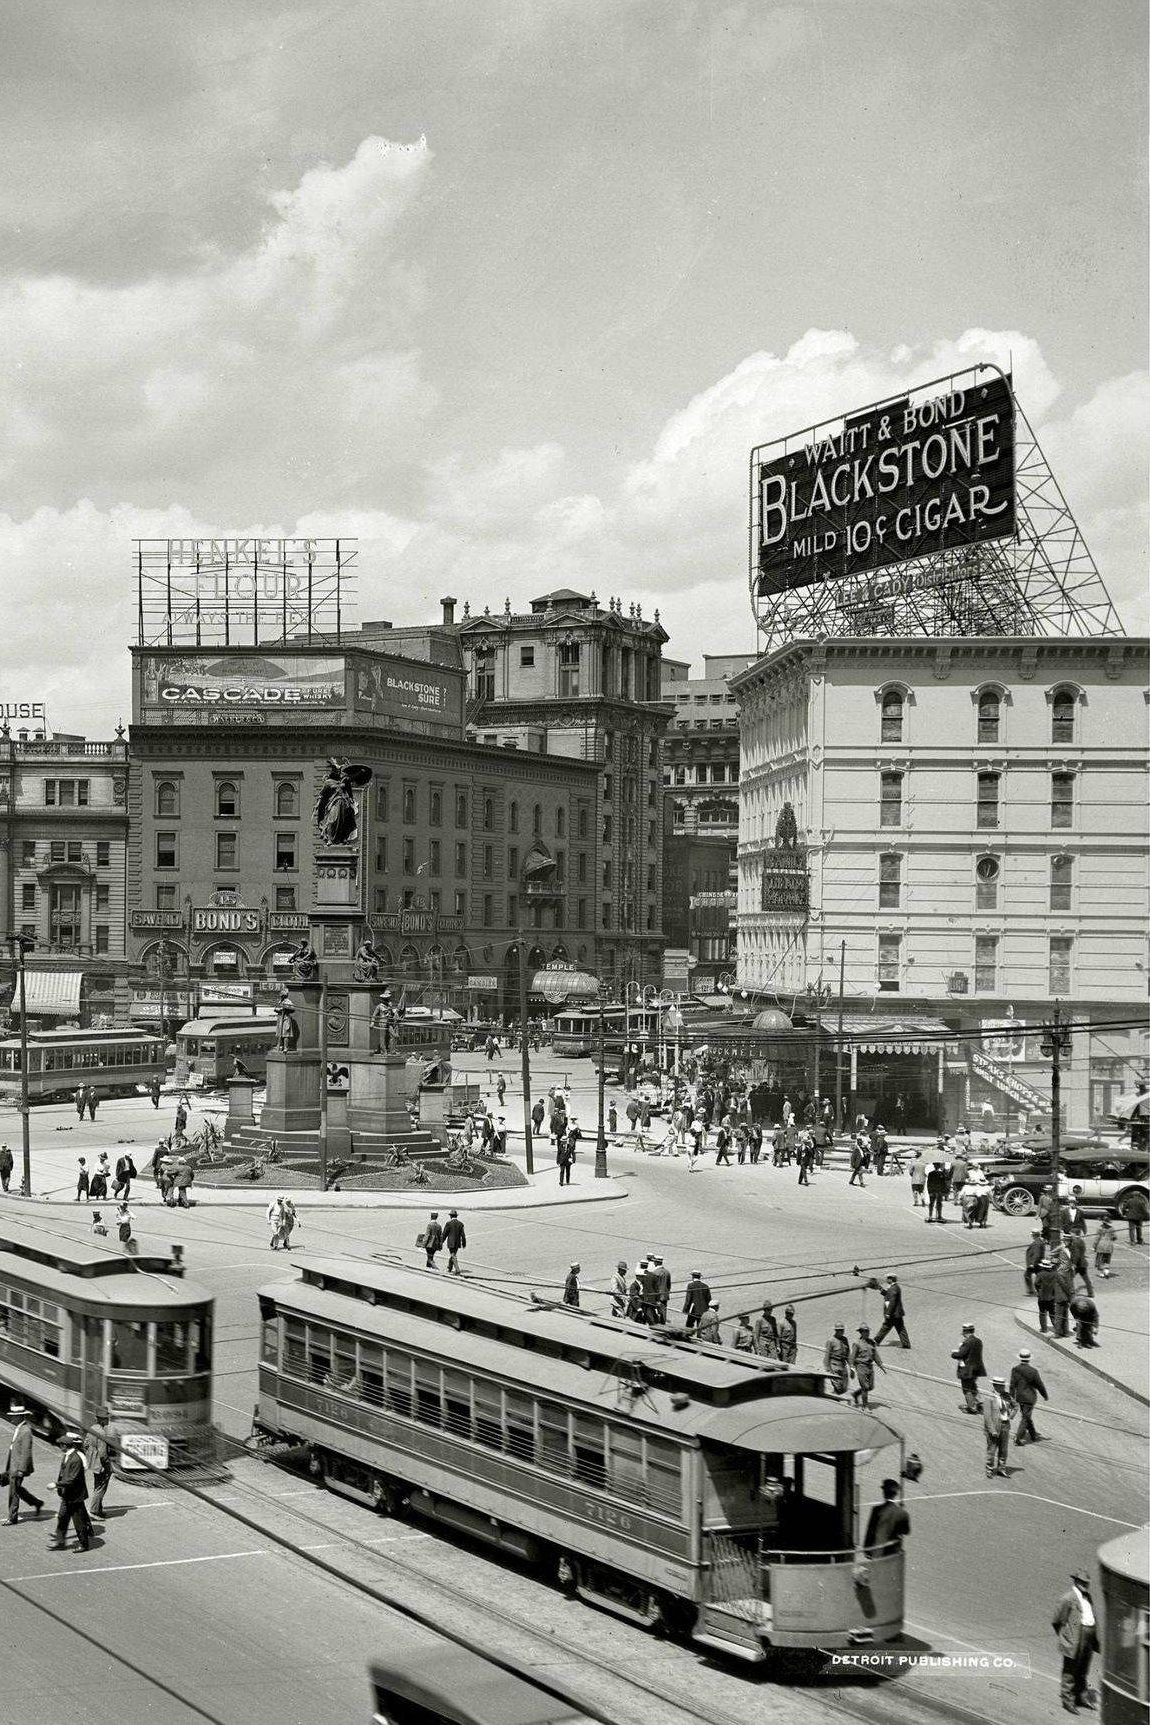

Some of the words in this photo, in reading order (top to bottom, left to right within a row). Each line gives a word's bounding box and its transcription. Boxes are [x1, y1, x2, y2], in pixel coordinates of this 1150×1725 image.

[805, 423, 871, 466] WAITT
[878, 416, 892, 442] &
[903, 389, 965, 434] BOND
[761, 414, 1000, 547] BLACKSTONE
[793, 531, 836, 559] MILD
[895, 484, 1008, 541] CIGAR
[196, 574, 301, 599] FLOUR
[161, 687, 301, 701] CASCADE
[387, 678, 440, 696] BLACKSTONE
[418, 694, 440, 705] SURE
[195, 913, 258, 930] BOND'S
[404, 914, 433, 932] BOND'S
[542, 963, 575, 971] TEMPLE
[584, 1501, 632, 1530] 7126
